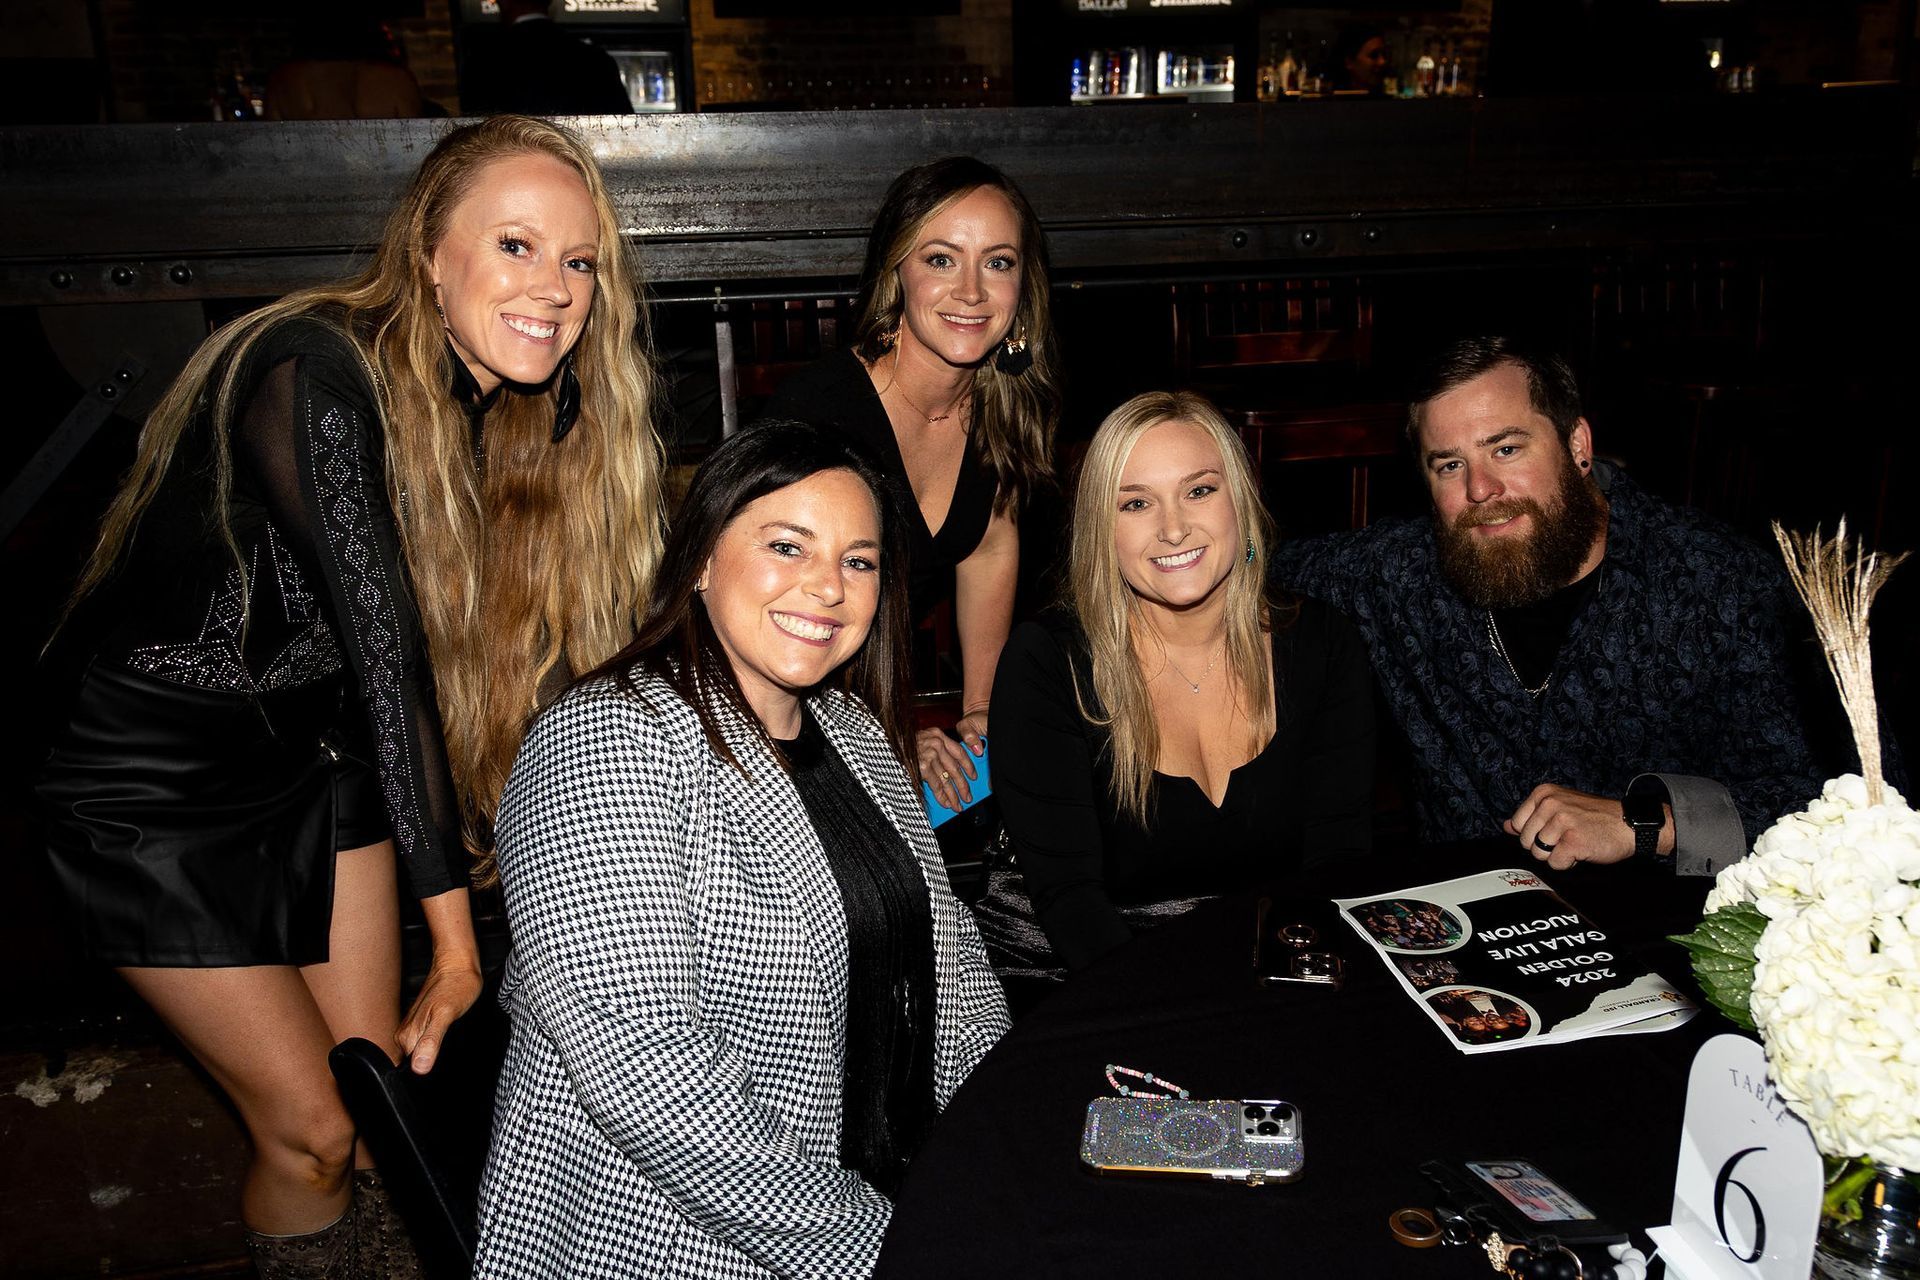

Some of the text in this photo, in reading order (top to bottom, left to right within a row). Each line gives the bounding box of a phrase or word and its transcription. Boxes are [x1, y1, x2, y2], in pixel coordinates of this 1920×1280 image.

[1477, 914, 1580, 942] AUCTION
[1487, 930, 1607, 960] GALA LIVE
[1517, 951, 1614, 975] GOLDEN
[1555, 968, 1617, 987] 2024
[1728, 1068, 1787, 1127] TABLE
[1714, 1146, 1768, 1264] 6
